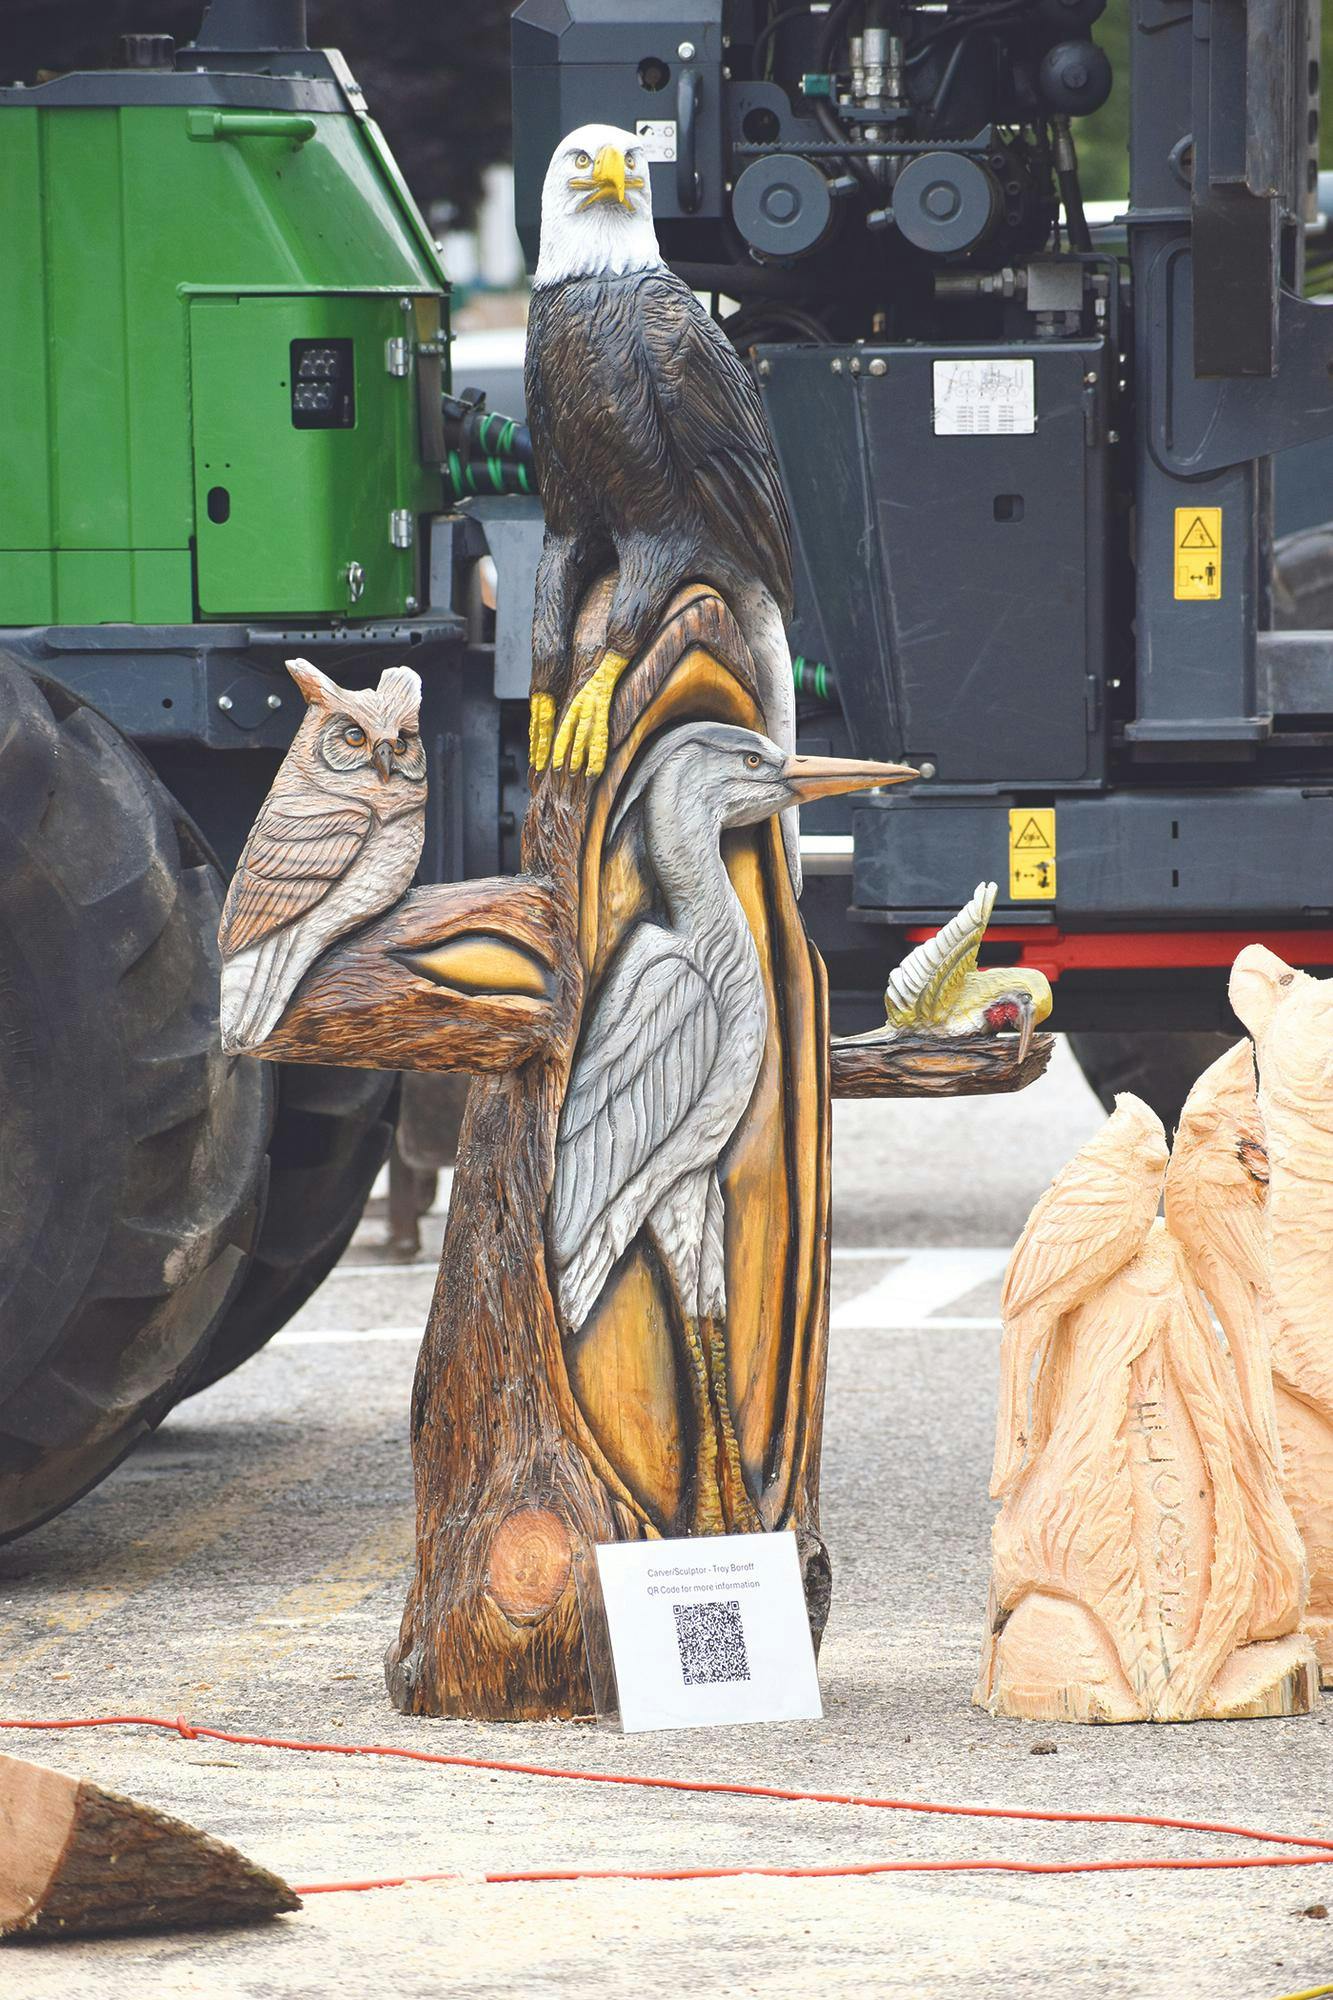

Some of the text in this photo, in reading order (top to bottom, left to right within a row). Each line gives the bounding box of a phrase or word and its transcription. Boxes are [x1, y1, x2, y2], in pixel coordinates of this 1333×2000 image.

[712, 1564, 729, 1575] Troy
[647, 1581, 760, 1596] QR Code for more information
